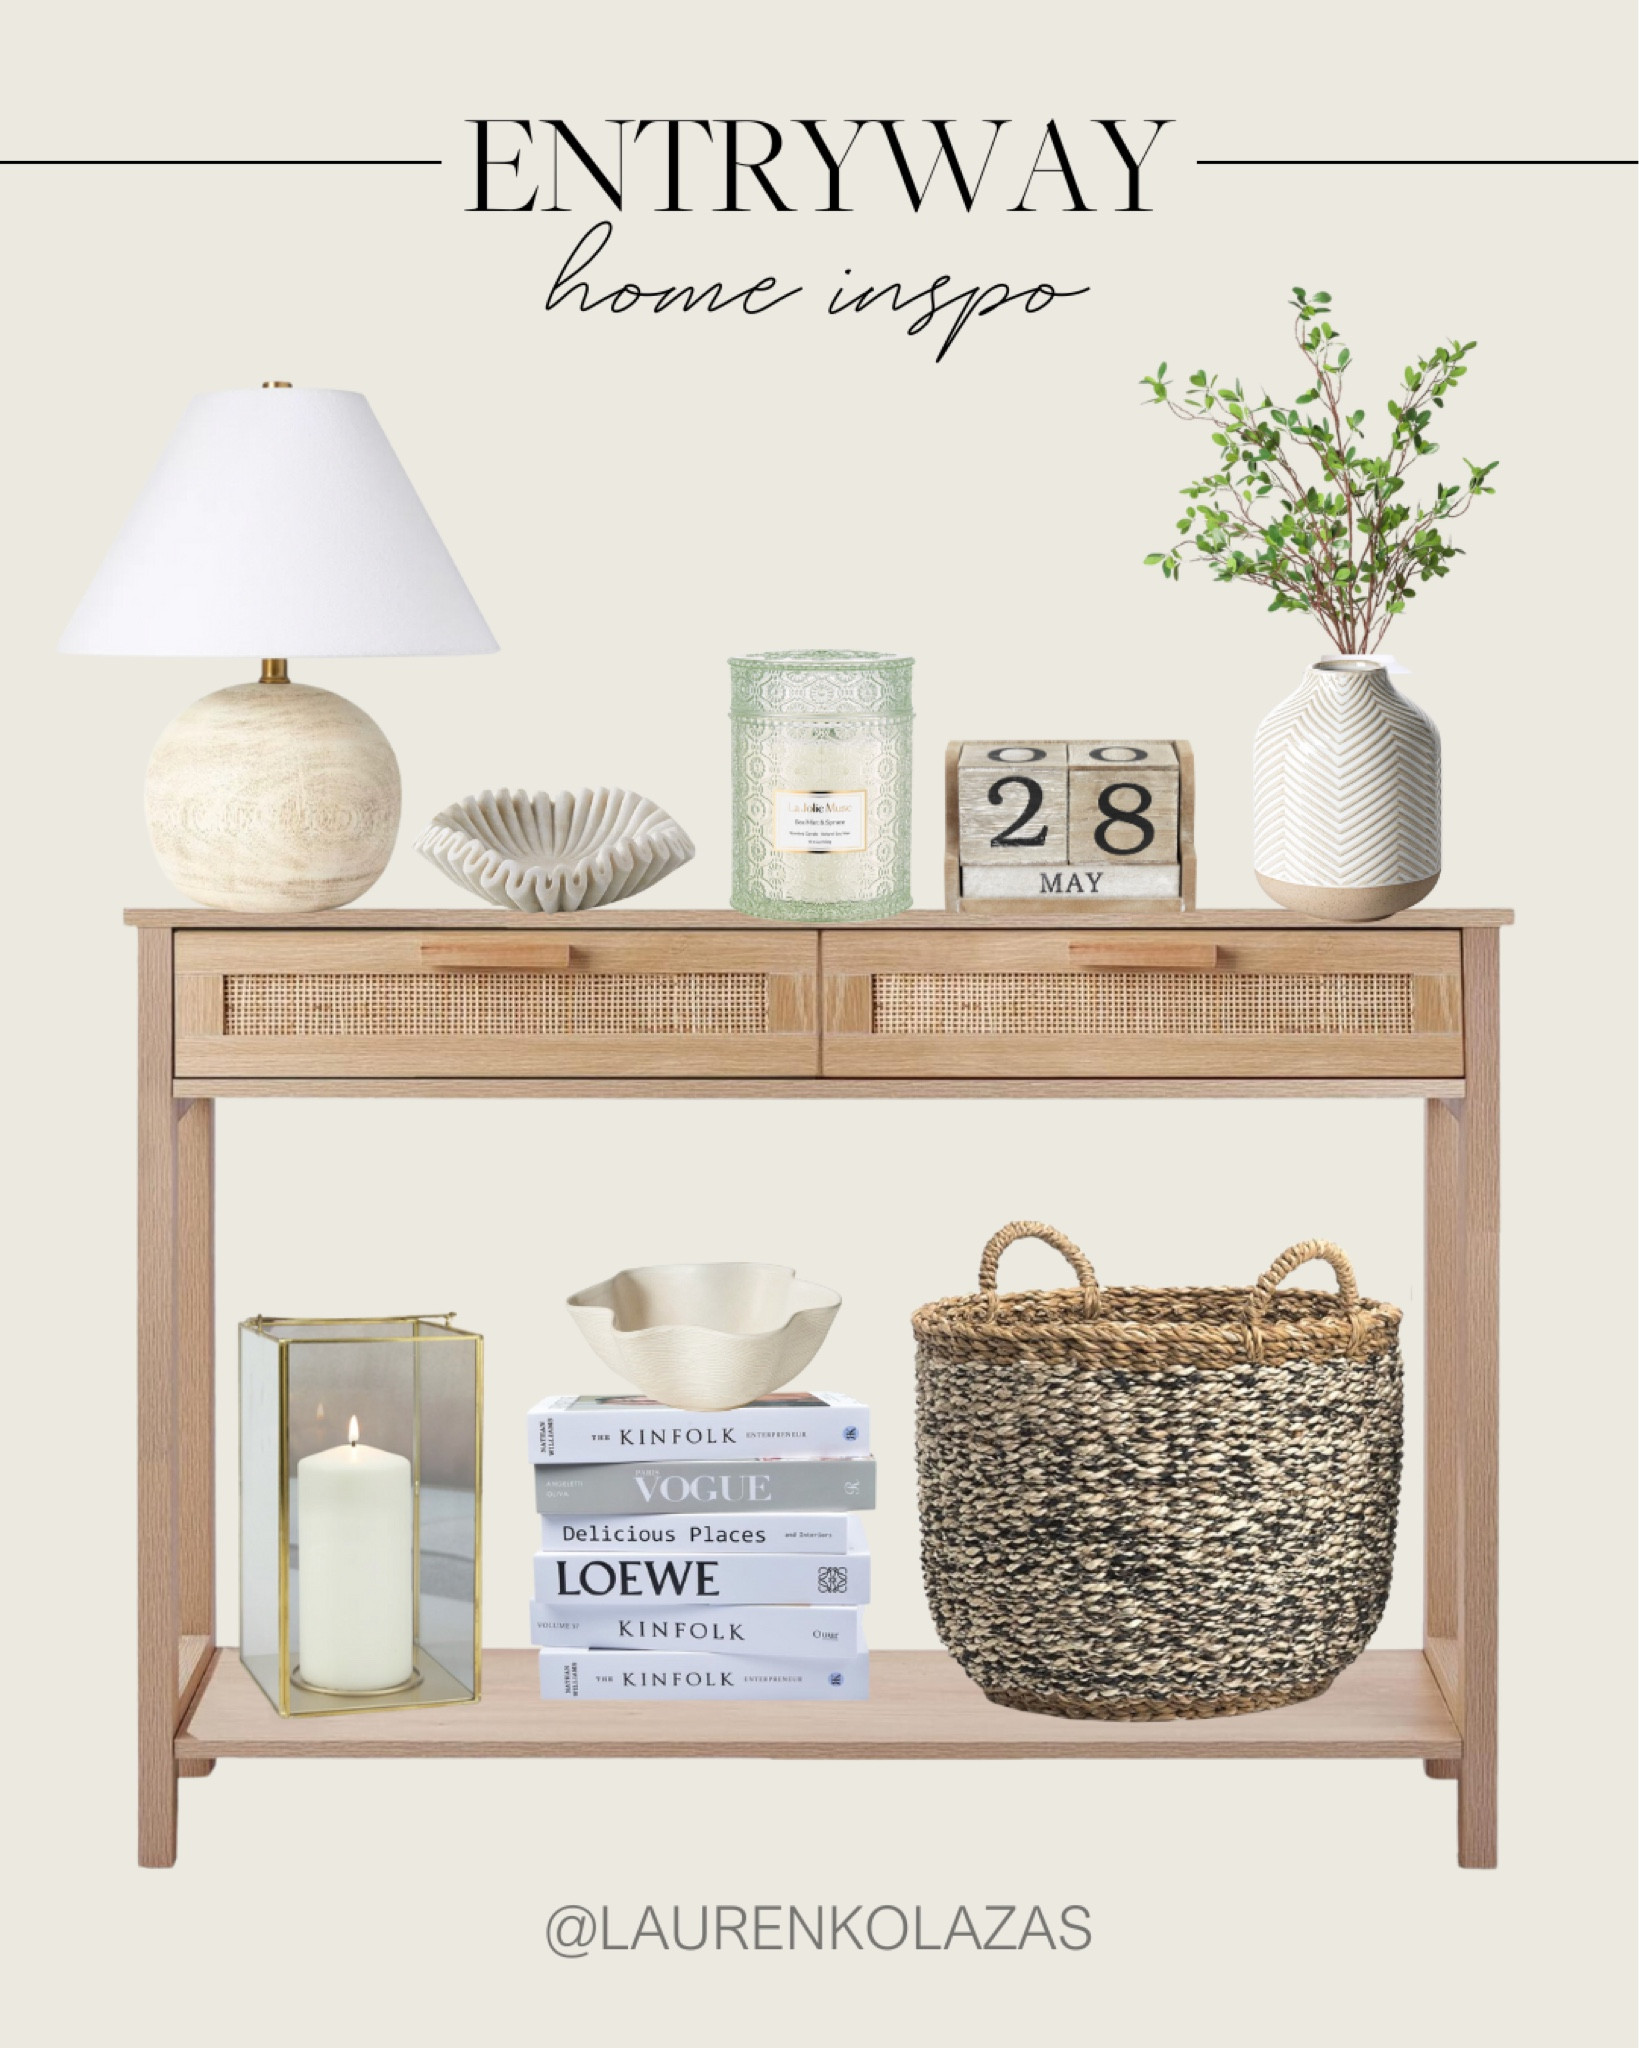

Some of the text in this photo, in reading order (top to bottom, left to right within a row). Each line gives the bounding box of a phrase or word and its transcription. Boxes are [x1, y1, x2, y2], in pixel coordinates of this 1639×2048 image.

[1039, 871, 1105, 893] MAY
[620, 1428, 737, 1446] KINFOLK
[634, 1474, 772, 1503] VOGUE
[562, 1525, 676, 1543] Delicious
[689, 1525, 766, 1544] Places
[556, 1560, 720, 1597] LOEWE
[618, 1619, 746, 1642] KINFOLK
[622, 1671, 735, 1688] KINFOLK
